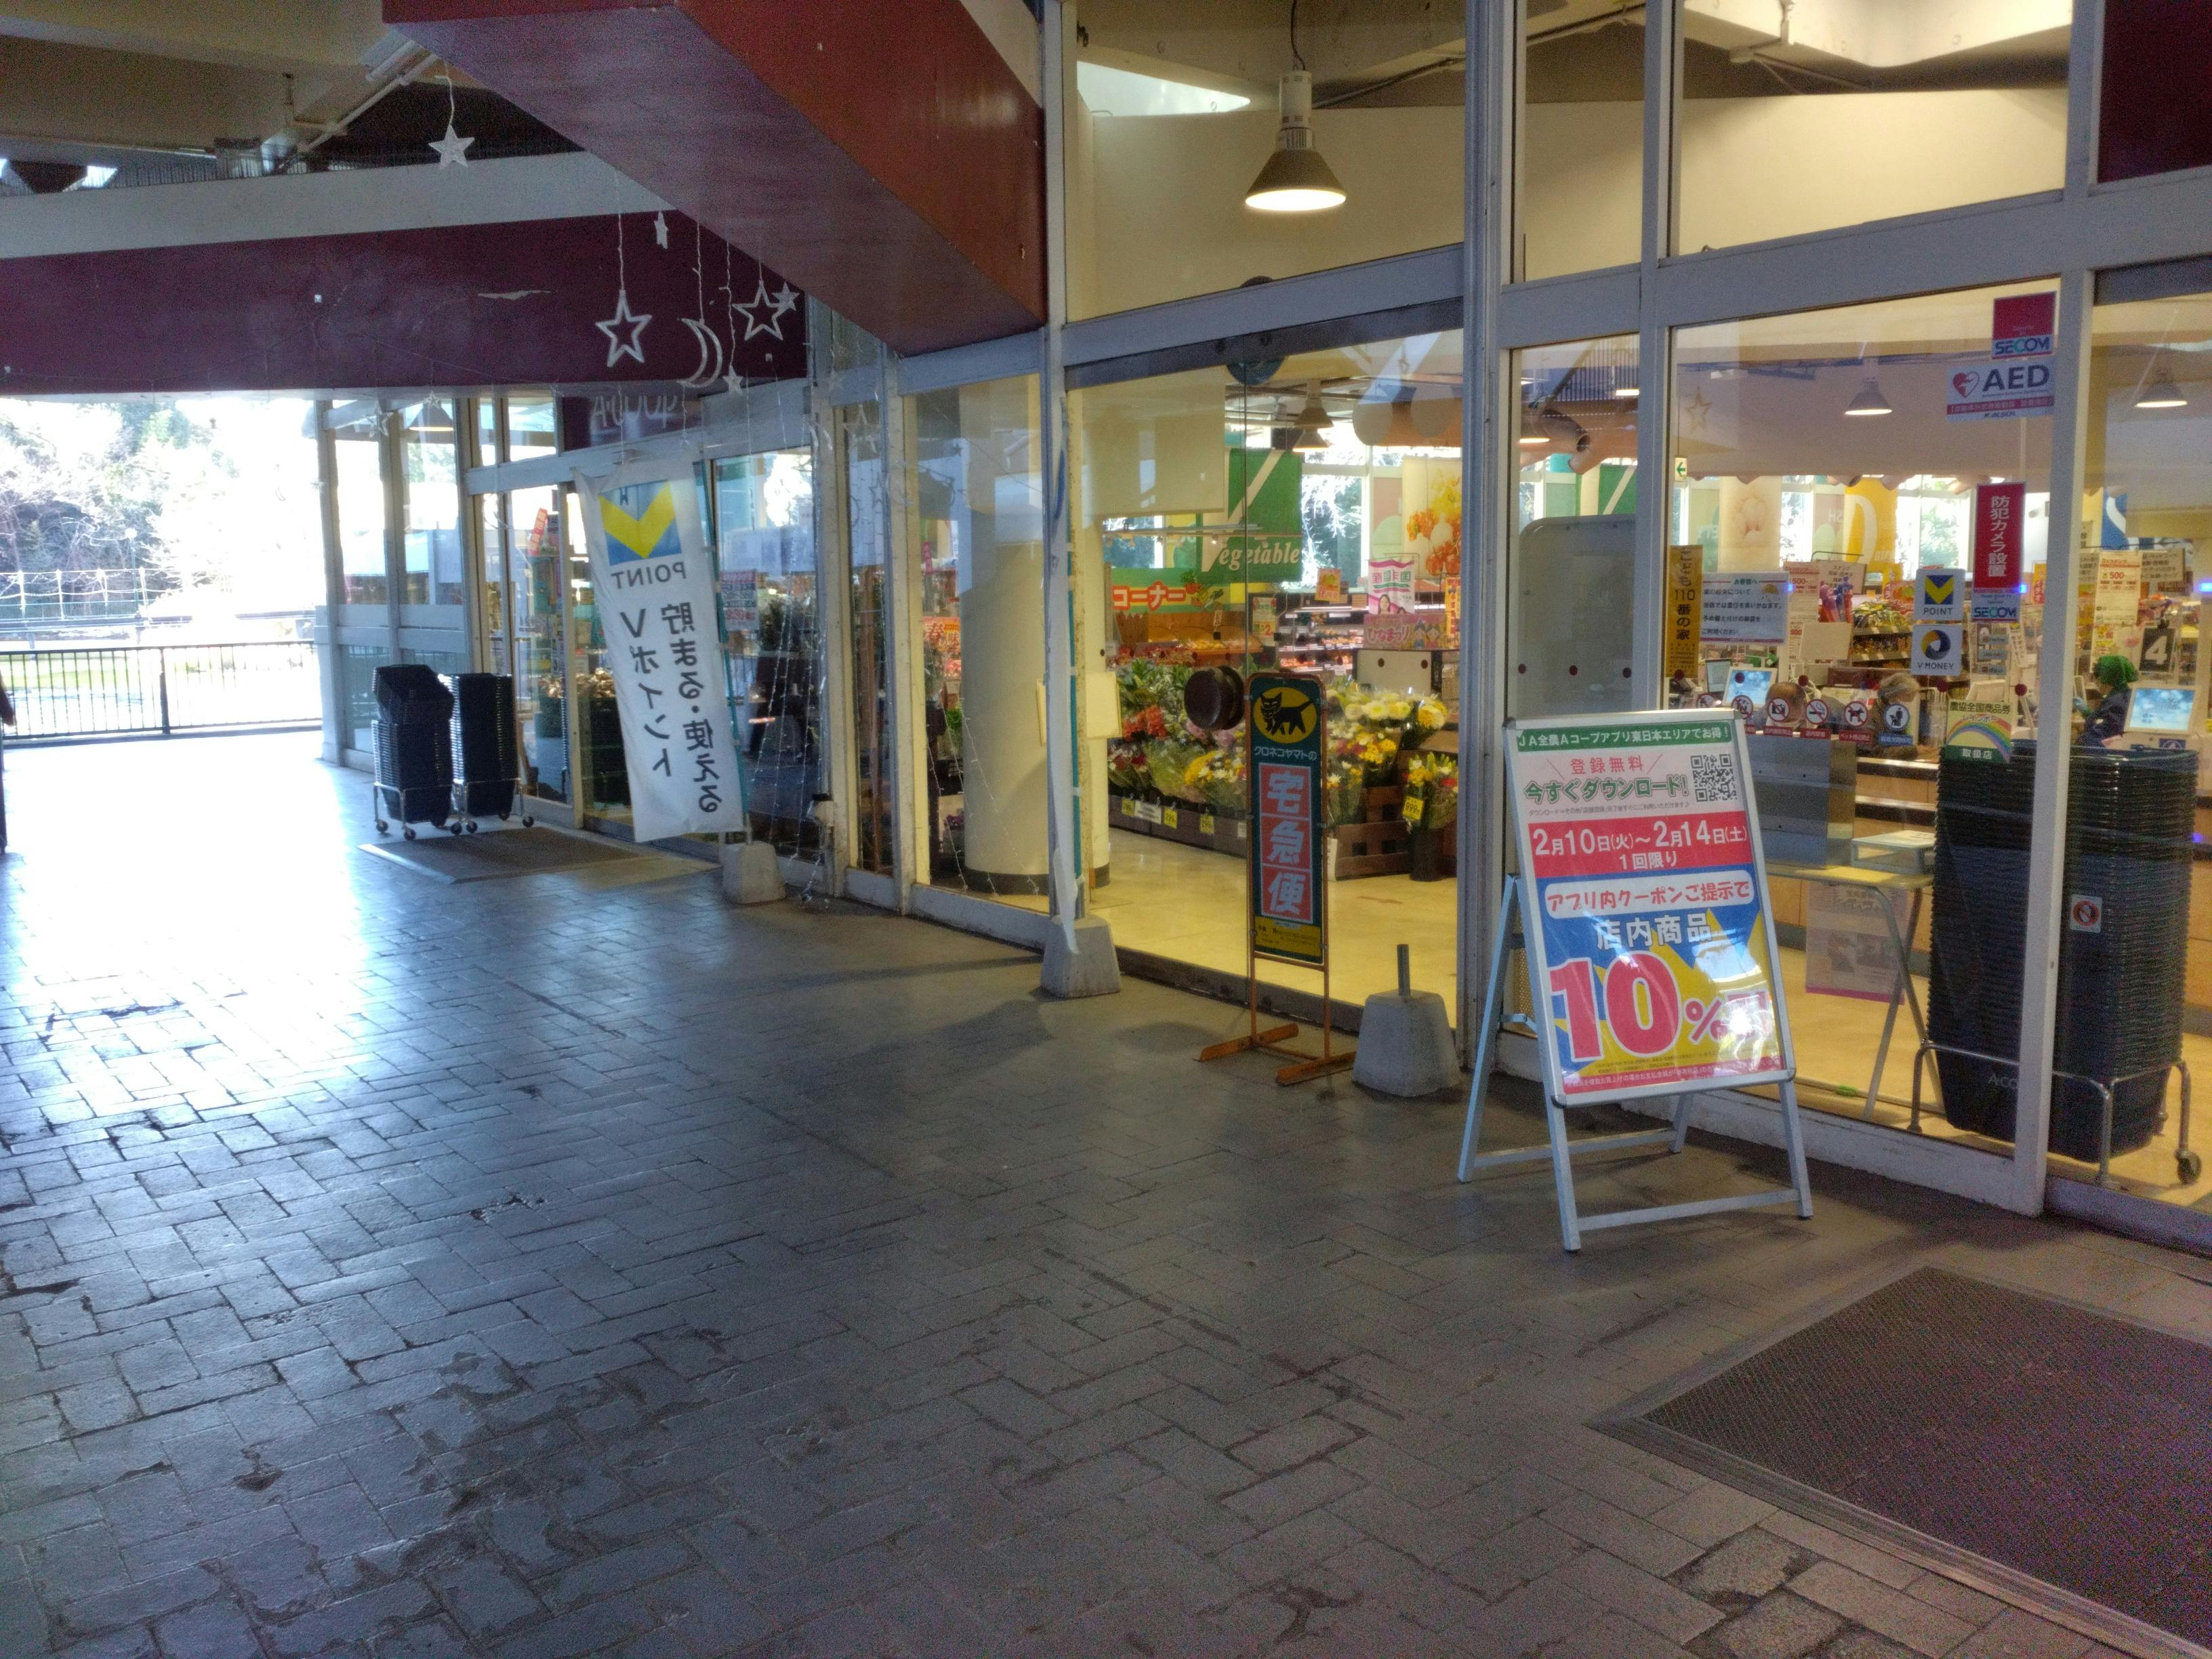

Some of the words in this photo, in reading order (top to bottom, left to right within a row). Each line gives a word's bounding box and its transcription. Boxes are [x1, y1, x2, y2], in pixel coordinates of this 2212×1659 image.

[1995, 337, 2050, 355] SECOM
[1982, 364, 2050, 392] AED
[1988, 495, 2010, 577] 防犯カメラ設置
[1112, 583, 1185, 609] コーナー
[1674, 548, 1696, 640] こども110番の家
[1923, 607, 1952, 615] POINT
[1973, 606, 2017, 618] SECOM
[2144, 635, 2169, 665] 4
[1926, 662, 1954, 670] MONEY
[1949, 701, 2011, 714] 農協全国商品券
[1254, 746, 1317, 760] クロネコヤマトの
[1962, 748, 1993, 760] 取扱店
[1570, 755, 1644, 775] 登録無料
[1267, 771, 1305, 914] 宅急便
[1618, 851, 1678, 872] 1回限り
[1547, 880, 1750, 912] アプリ内クーポンご提示で
[1595, 913, 1712, 949] 店内商品
